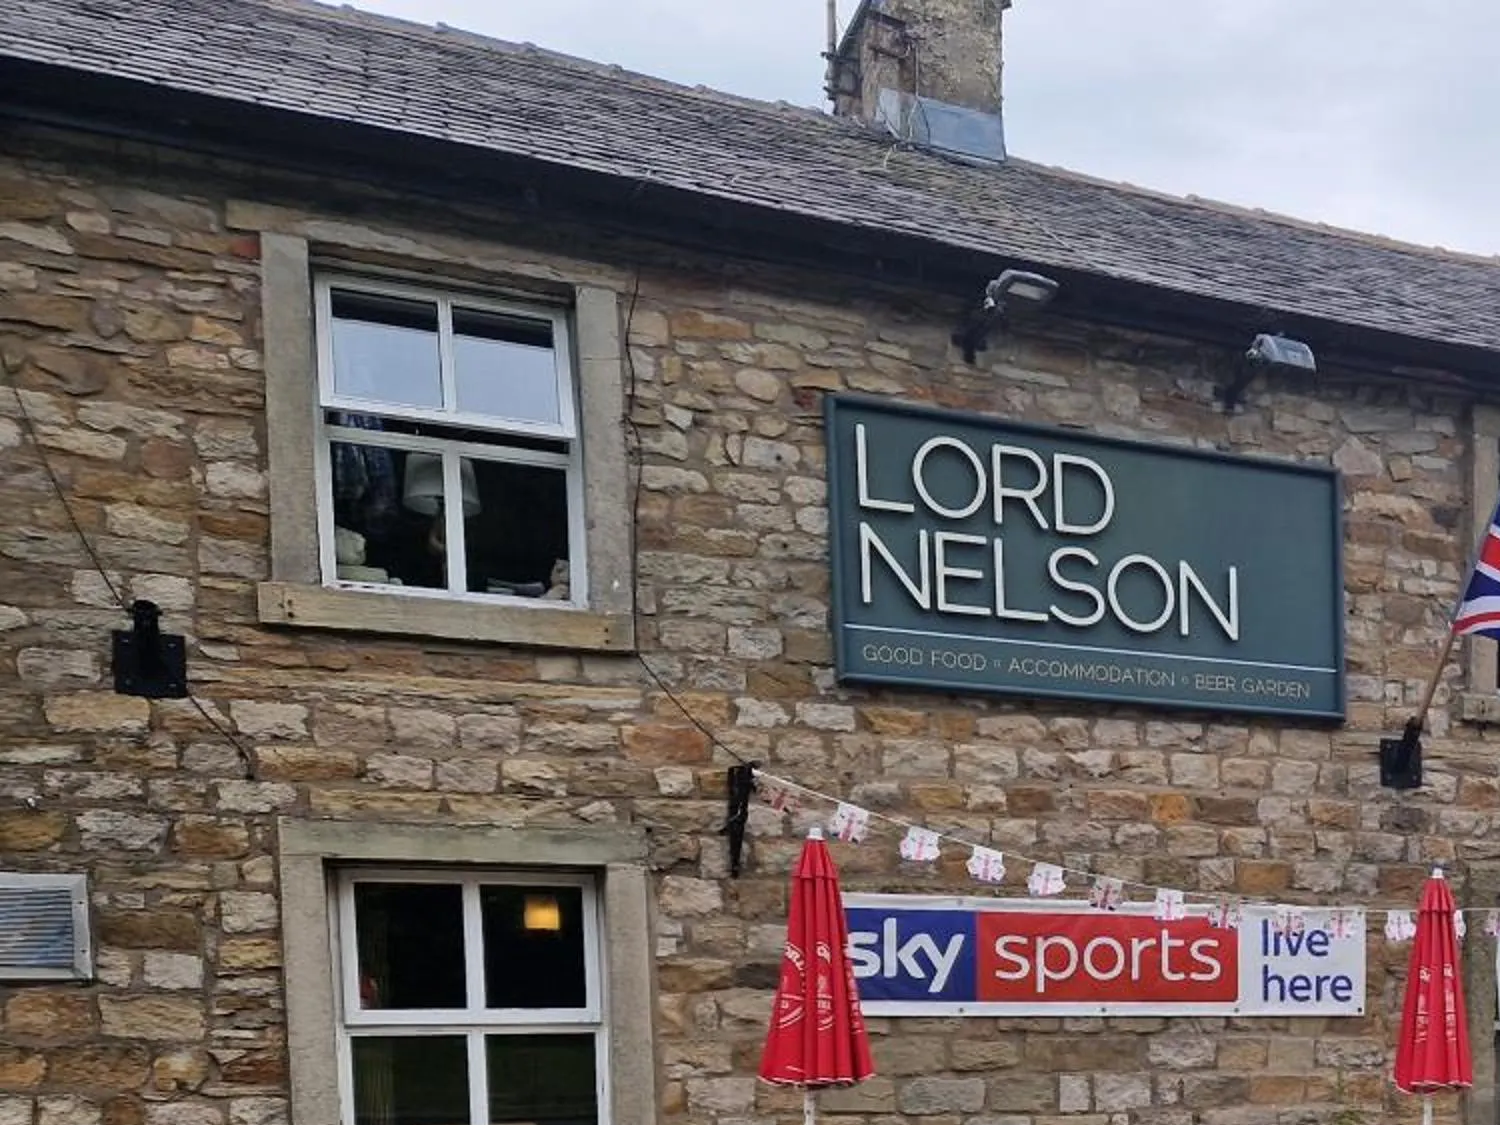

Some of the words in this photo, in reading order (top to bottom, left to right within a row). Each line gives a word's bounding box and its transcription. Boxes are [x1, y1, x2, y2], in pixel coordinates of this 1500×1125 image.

[855, 422, 1115, 535] LORD
[858, 521, 1240, 642] NELSON
[862, 644, 924, 667] GOOD
[931, 649, 988, 672] FOOD
[1007, 656, 1176, 688] ACCOMMODATION
[1194, 673, 1237, 692] BEER
[1242, 677, 1311, 699] GARDEN
[845, 917, 966, 994] sky
[994, 928, 1223, 994] sports
[1261, 918, 1331, 958] live
[1262, 965, 1354, 1003] here
